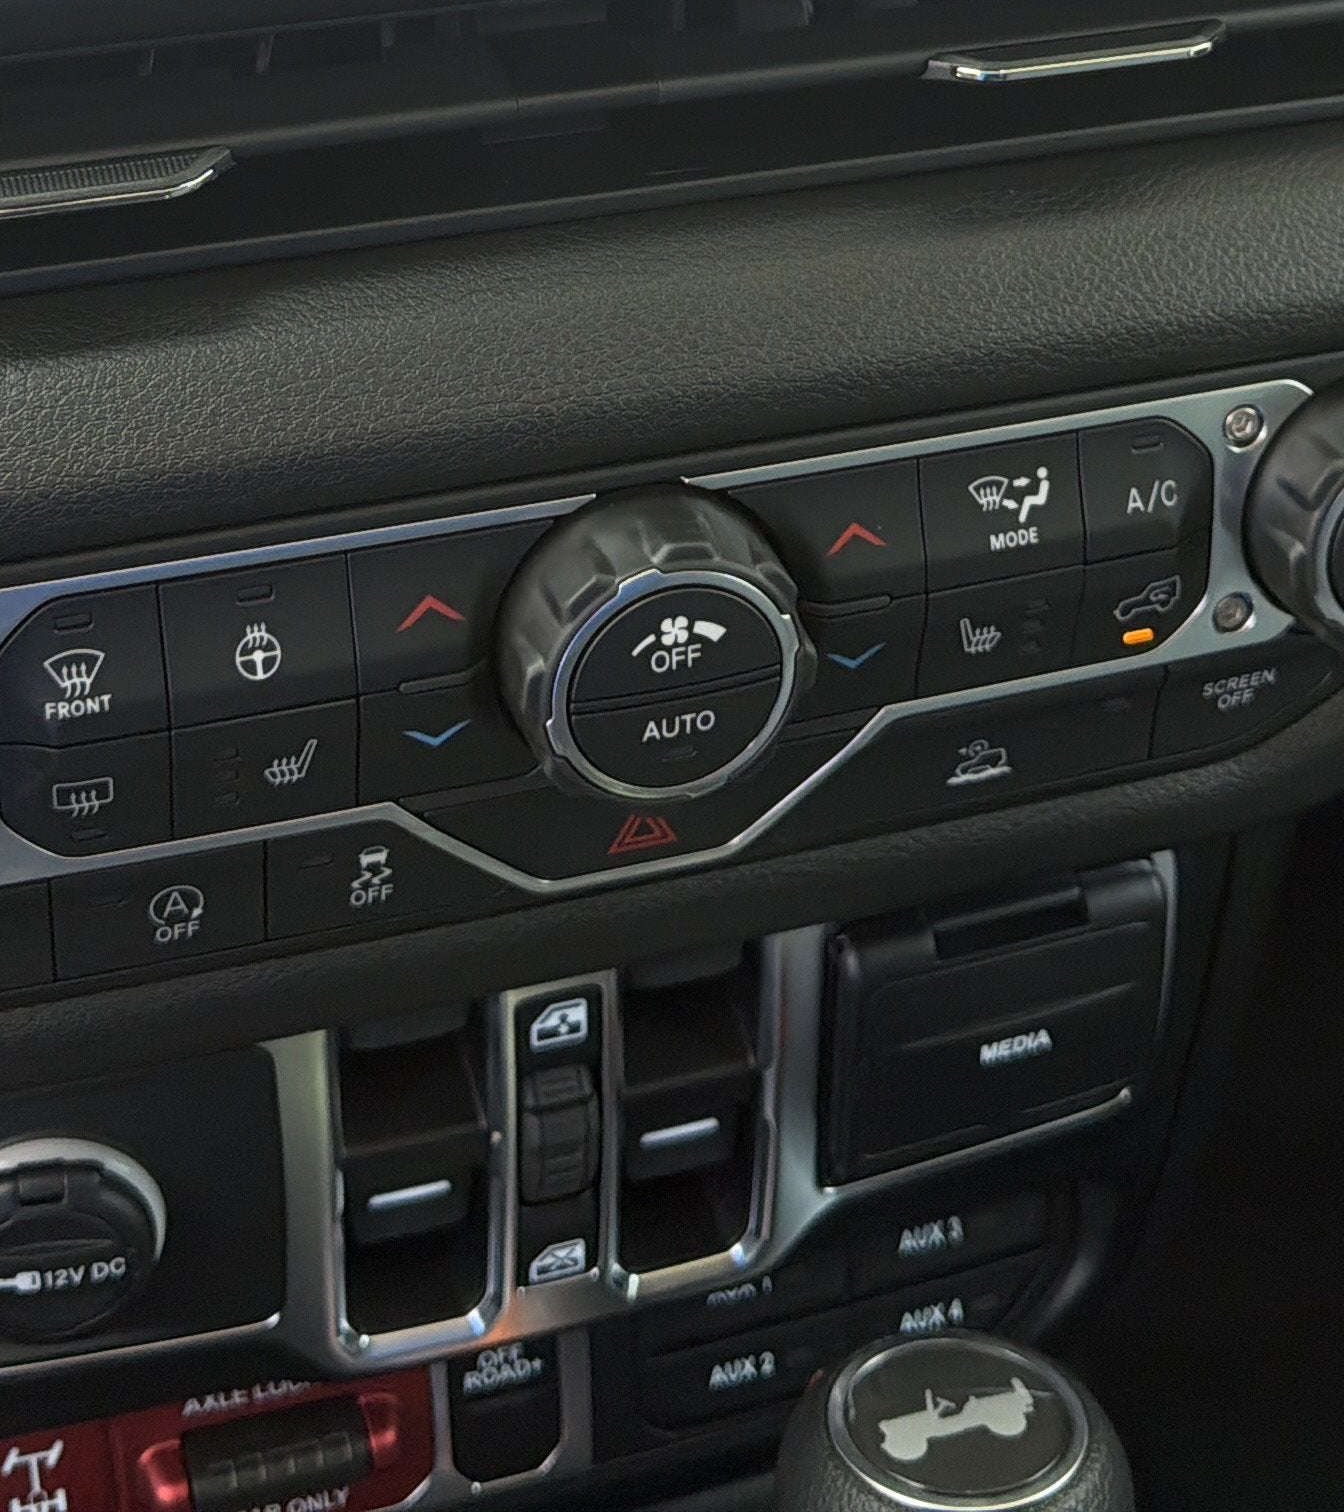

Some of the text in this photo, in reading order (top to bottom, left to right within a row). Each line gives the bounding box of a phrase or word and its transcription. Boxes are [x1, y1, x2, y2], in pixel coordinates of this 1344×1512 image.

[1126, 479, 1179, 515] A/C
[989, 526, 1040, 552] MODE
[650, 644, 703, 674] OFF
[1202, 667, 1277, 698] SCREEN
[44, 693, 113, 721] FRONT
[1216, 688, 1255, 712] OFF
[641, 709, 717, 743] AUTO
[349, 884, 394, 907] OFF
[156, 920, 201, 942] OFF
[979, 1028, 1053, 1066] MEDIA
[898, 1219, 947, 1256] AUX
[44, 1256, 127, 1289] 12V DC
[900, 1302, 946, 1333] AUX
[709, 1351, 776, 1389] AUX 2
